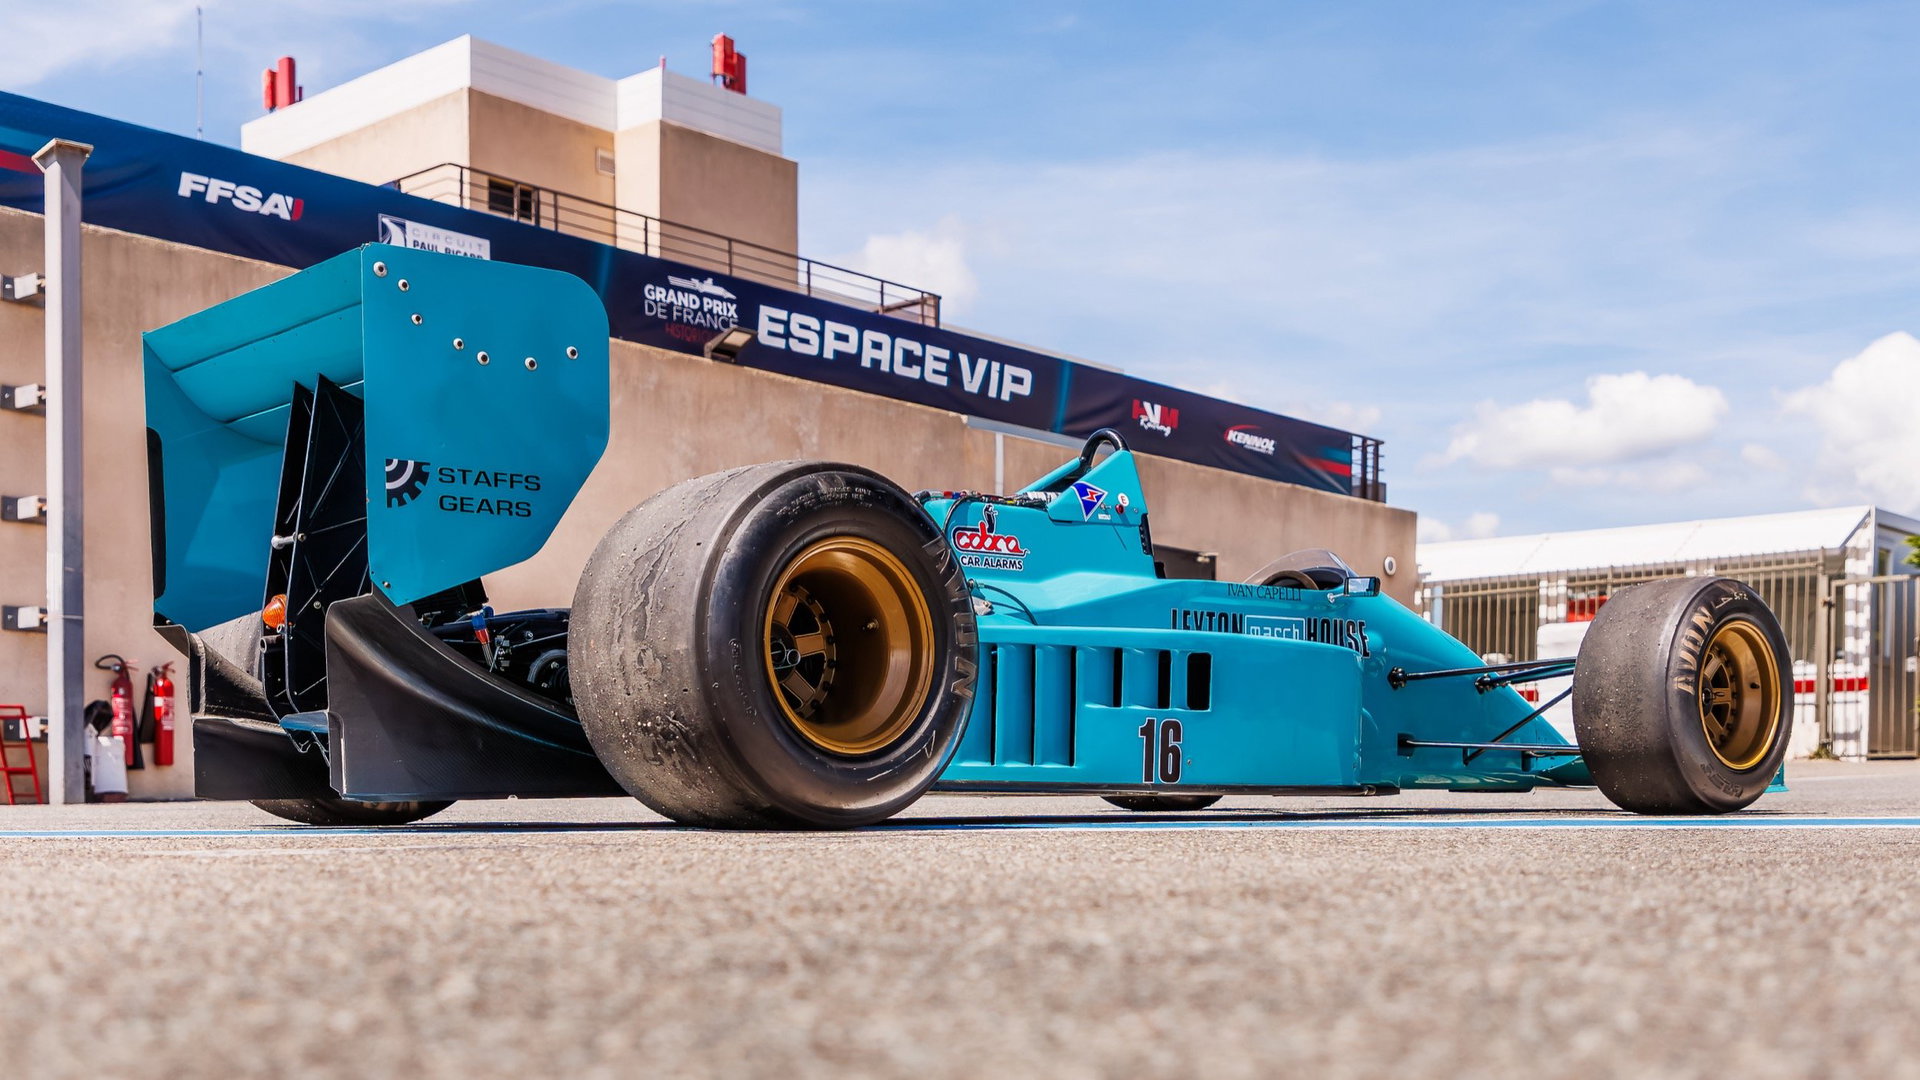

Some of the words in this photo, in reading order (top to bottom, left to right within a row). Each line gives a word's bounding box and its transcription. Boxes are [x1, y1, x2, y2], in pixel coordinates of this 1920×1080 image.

[178, 171, 293, 221] FFSA
[412, 227, 484, 251] CIRCUIT
[412, 239, 440, 254] PAUL
[644, 283, 701, 310] GRAND
[702, 297, 738, 319] PRIX
[644, 299, 668, 319] DE
[672, 305, 739, 332] FRANCE
[757, 304, 950, 387] ESPACE
[957, 352, 1033, 402] VIP
[1227, 430, 1276, 451] KENNOL
[438, 467, 541, 492] STAFFS
[439, 494, 533, 518] GEARS
[956, 520, 1025, 554] cobra
[960, 555, 980, 567] CAR
[983, 557, 1024, 571] ALARMS
[1227, 583, 1253, 598] IVAN
[1256, 586, 1302, 601] CAPELLI
[1306, 616, 1371, 658] HOUSE
[1673, 605, 1715, 696] AVON
[1138, 717, 1183, 785] 16
